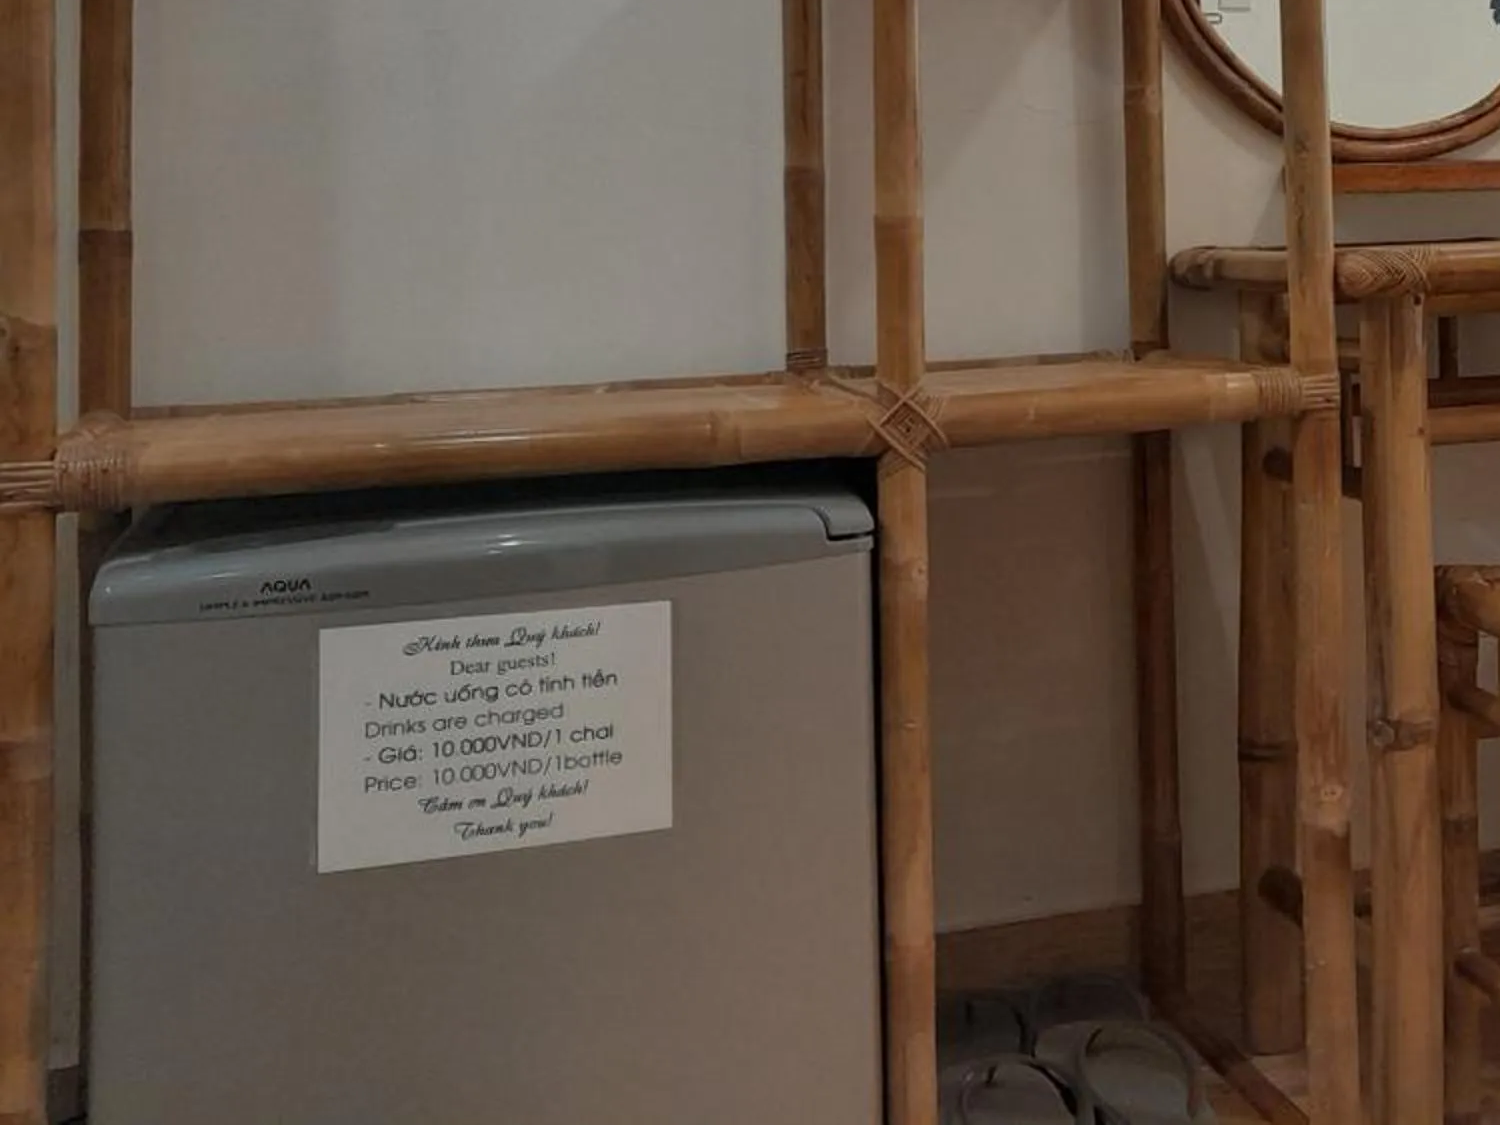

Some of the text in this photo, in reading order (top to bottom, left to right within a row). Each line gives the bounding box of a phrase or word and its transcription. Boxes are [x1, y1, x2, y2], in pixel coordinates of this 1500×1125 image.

[259, 578, 311, 594] AQUA
[450, 652, 556, 676] Dear guests!
[379, 690, 438, 710] Nước
[444, 683, 499, 705] uống
[506, 678, 533, 698] có
[364, 703, 565, 739] Drinks are charged
[569, 723, 614, 744] chai
[364, 774, 422, 794] Price:
[454, 811, 554, 841] Thank you!
